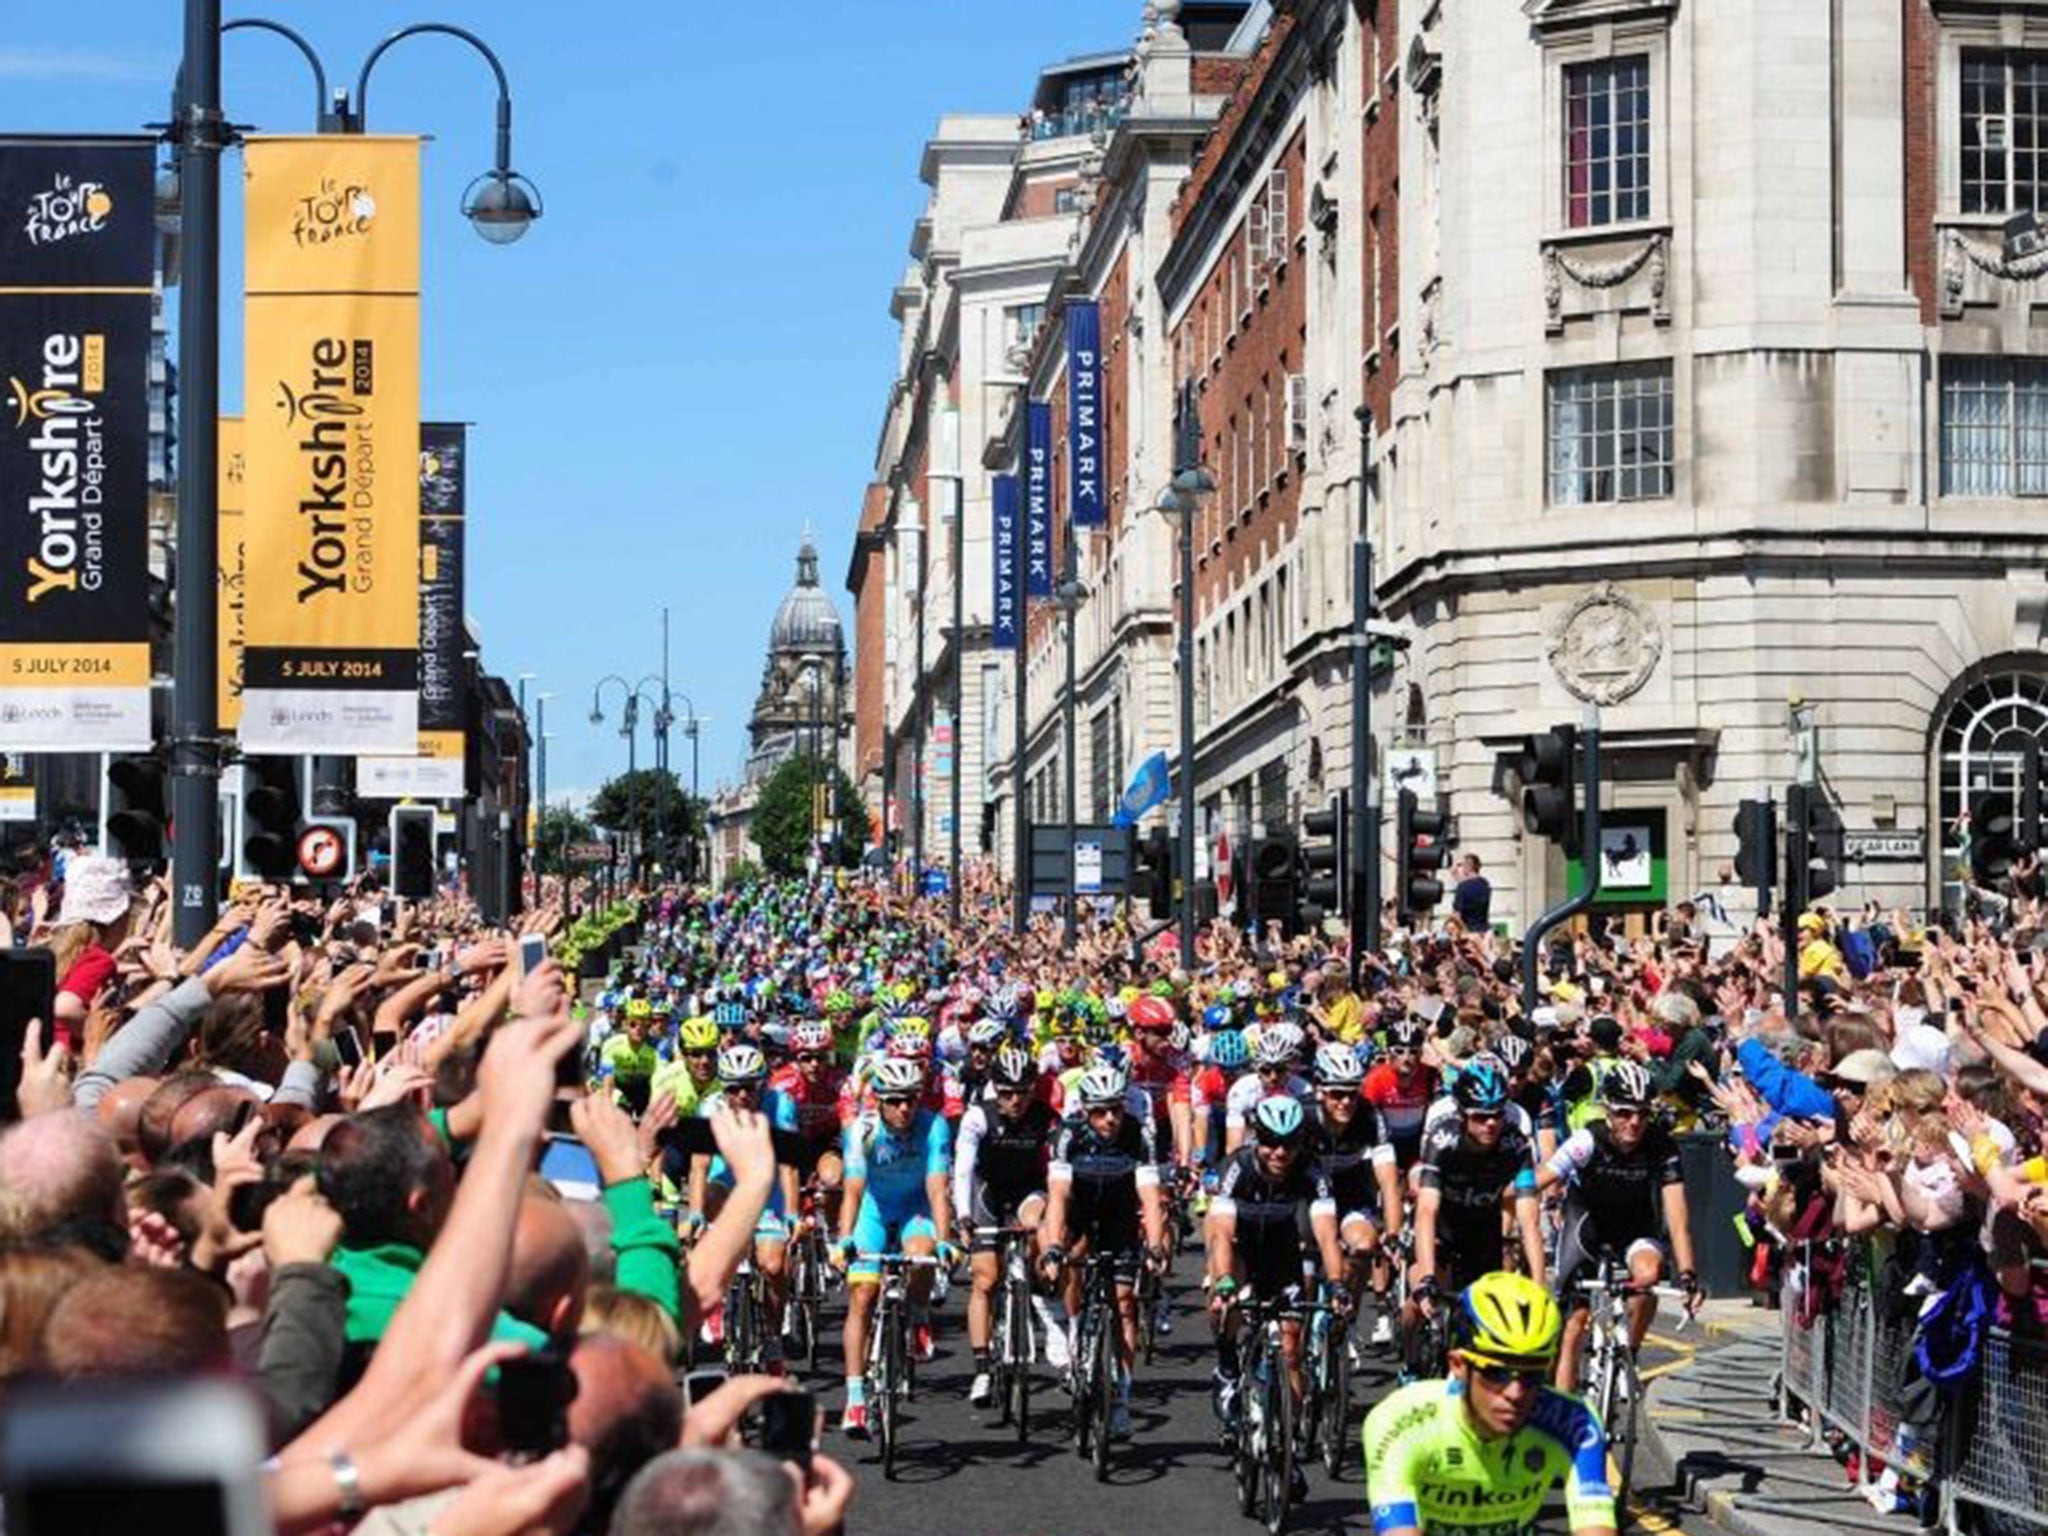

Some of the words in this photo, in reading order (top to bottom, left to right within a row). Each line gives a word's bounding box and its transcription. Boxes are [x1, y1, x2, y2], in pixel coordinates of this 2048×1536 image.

[355, 345, 370, 389] 2014
[81, 416, 106, 504] Départ
[1077, 351, 1095, 499] PRIMARK
[1030, 448, 1045, 576] PRIMARK
[81, 513, 102, 590] Grand
[352, 516, 374, 594] Grand
[1000, 516, 1013, 634] PRIMARK
[12, 658, 22, 674] 5
[26, 658, 67, 674] JULY
[72, 658, 112, 674] 2014
[282, 661, 293, 677] 5
[297, 661, 338, 677] JULY
[342, 661, 382, 677] 2014
